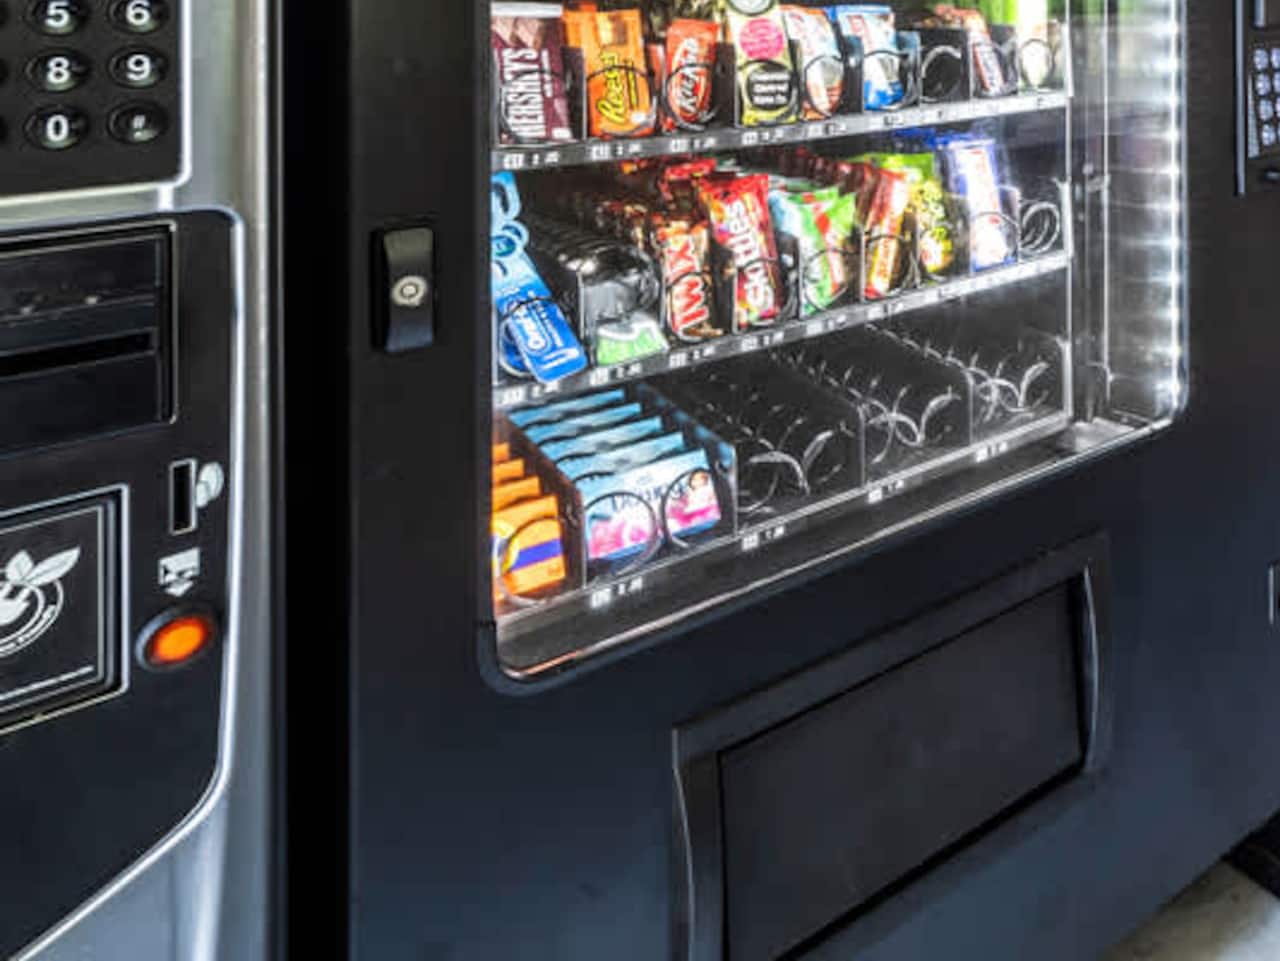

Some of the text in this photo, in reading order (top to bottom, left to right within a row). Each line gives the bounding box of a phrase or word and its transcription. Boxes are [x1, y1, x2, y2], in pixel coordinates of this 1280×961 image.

[45, 1, 71, 28] 5
[126, 0, 151, 26] 6
[47, 56, 71, 84] 8
[126, 54, 151, 81] 9
[46, 114, 69, 142] 0
